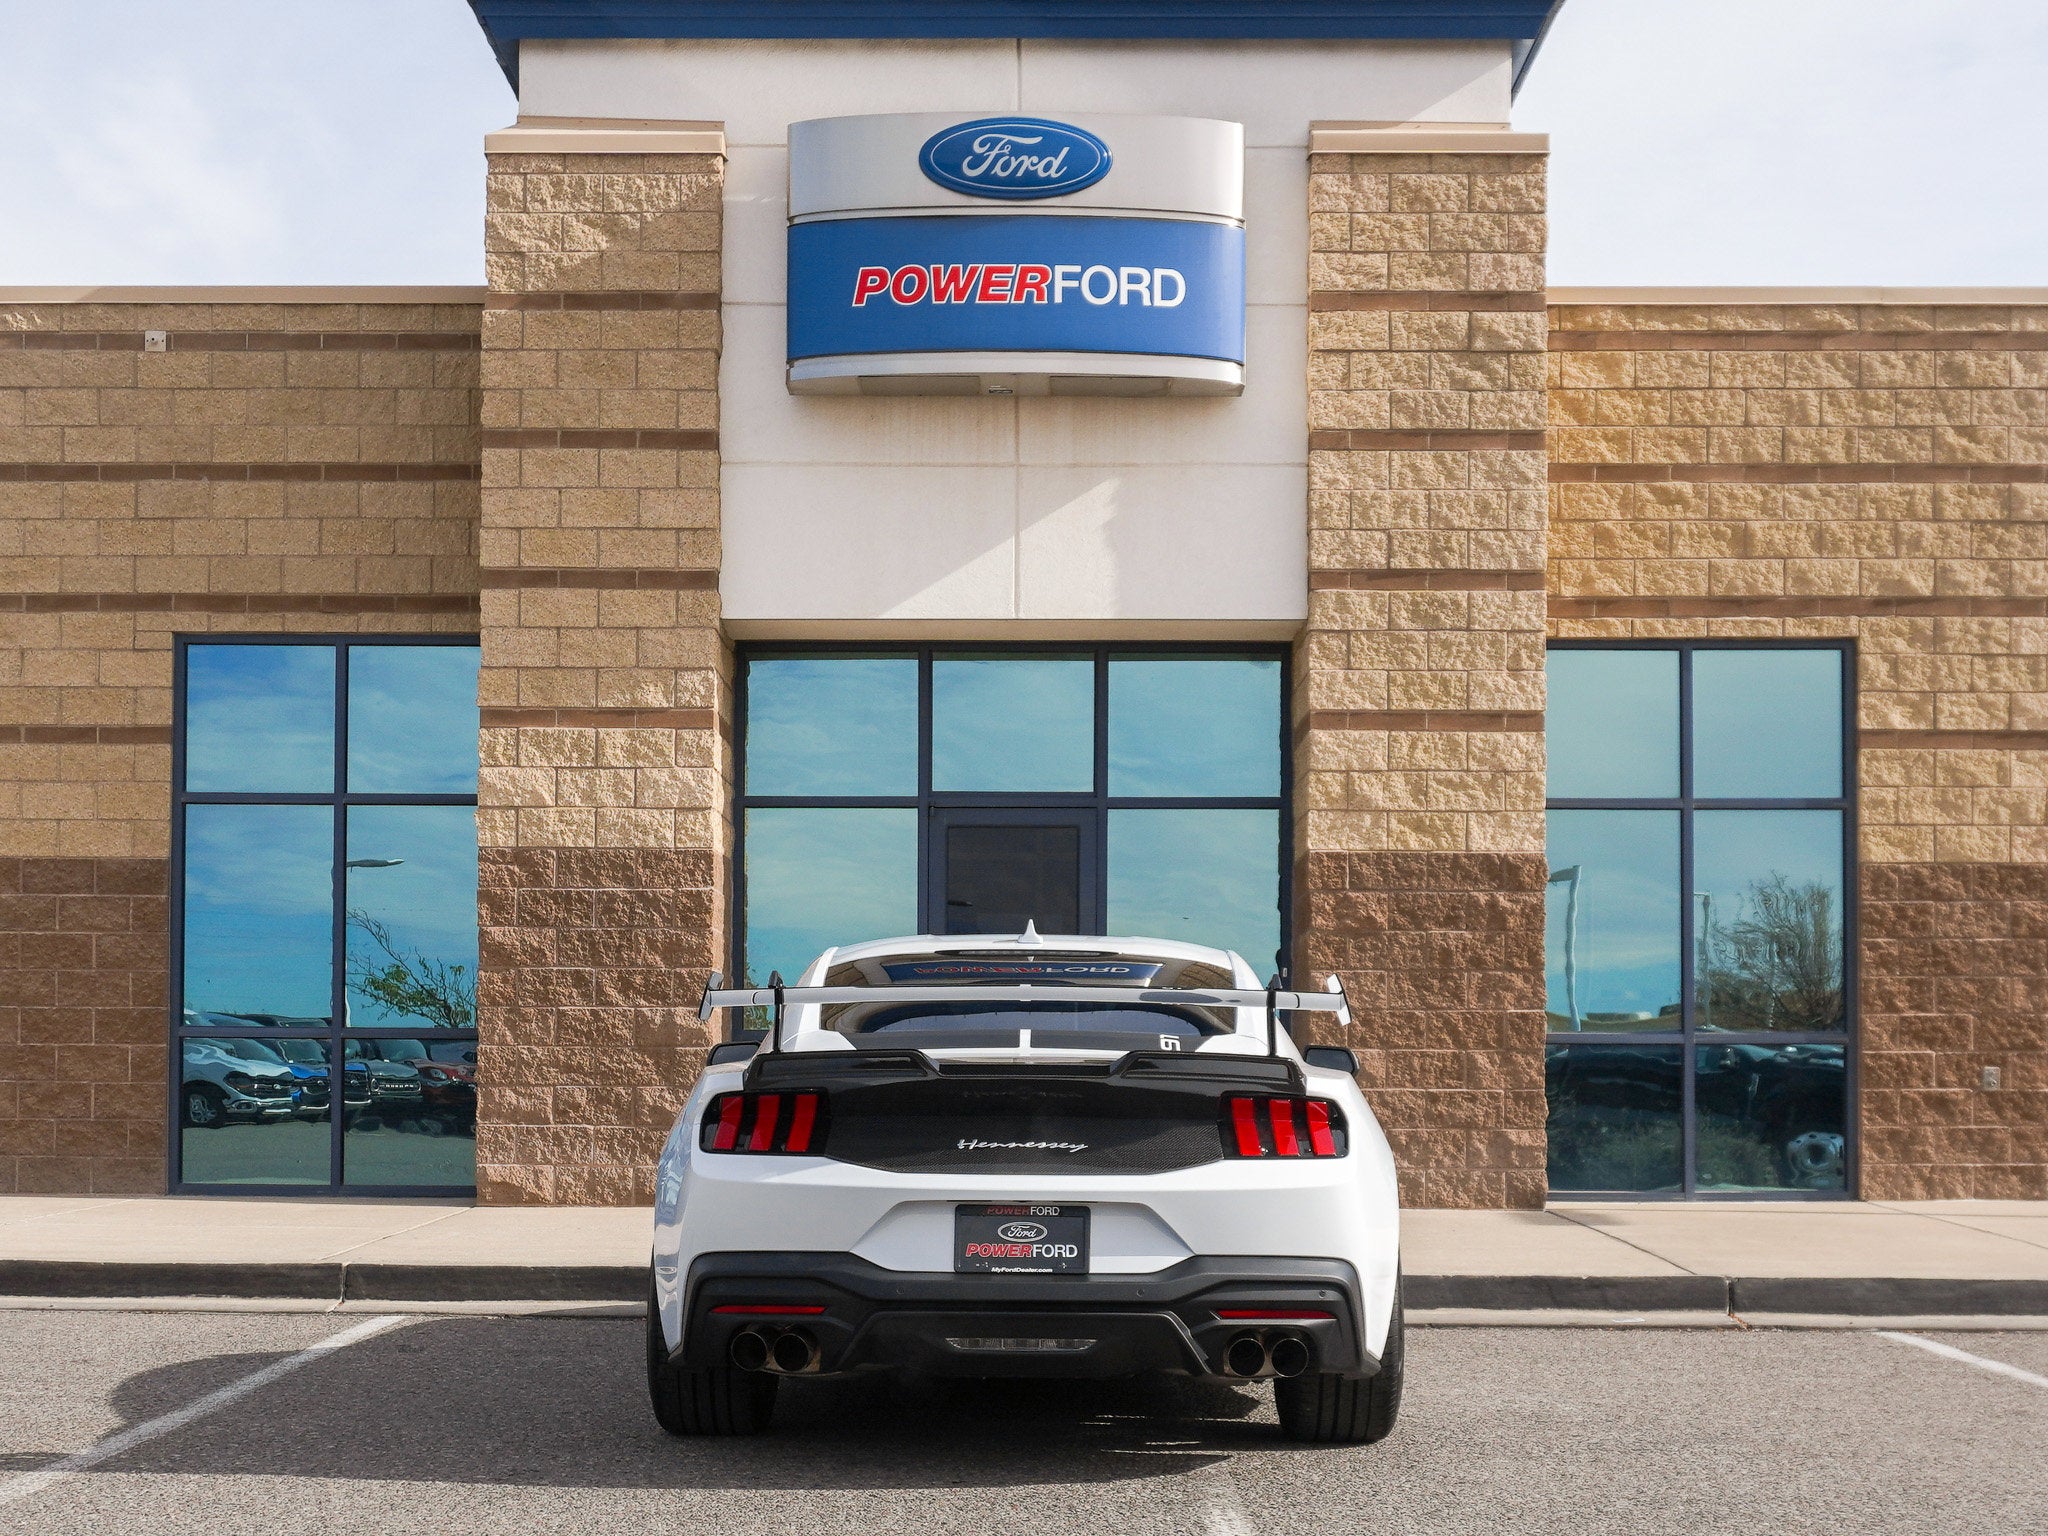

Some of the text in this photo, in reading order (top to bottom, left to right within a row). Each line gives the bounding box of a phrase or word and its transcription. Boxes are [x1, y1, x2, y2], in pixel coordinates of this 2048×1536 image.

[962, 133, 1070, 179] Ford
[852, 263, 1187, 308] POWERFORD
[957, 1139, 1089, 1153] Hennessey
[987, 1206, 1060, 1216] POWERFORD
[1008, 1225, 1037, 1238] Ford
[966, 1243, 1078, 1258] POWERFORD
